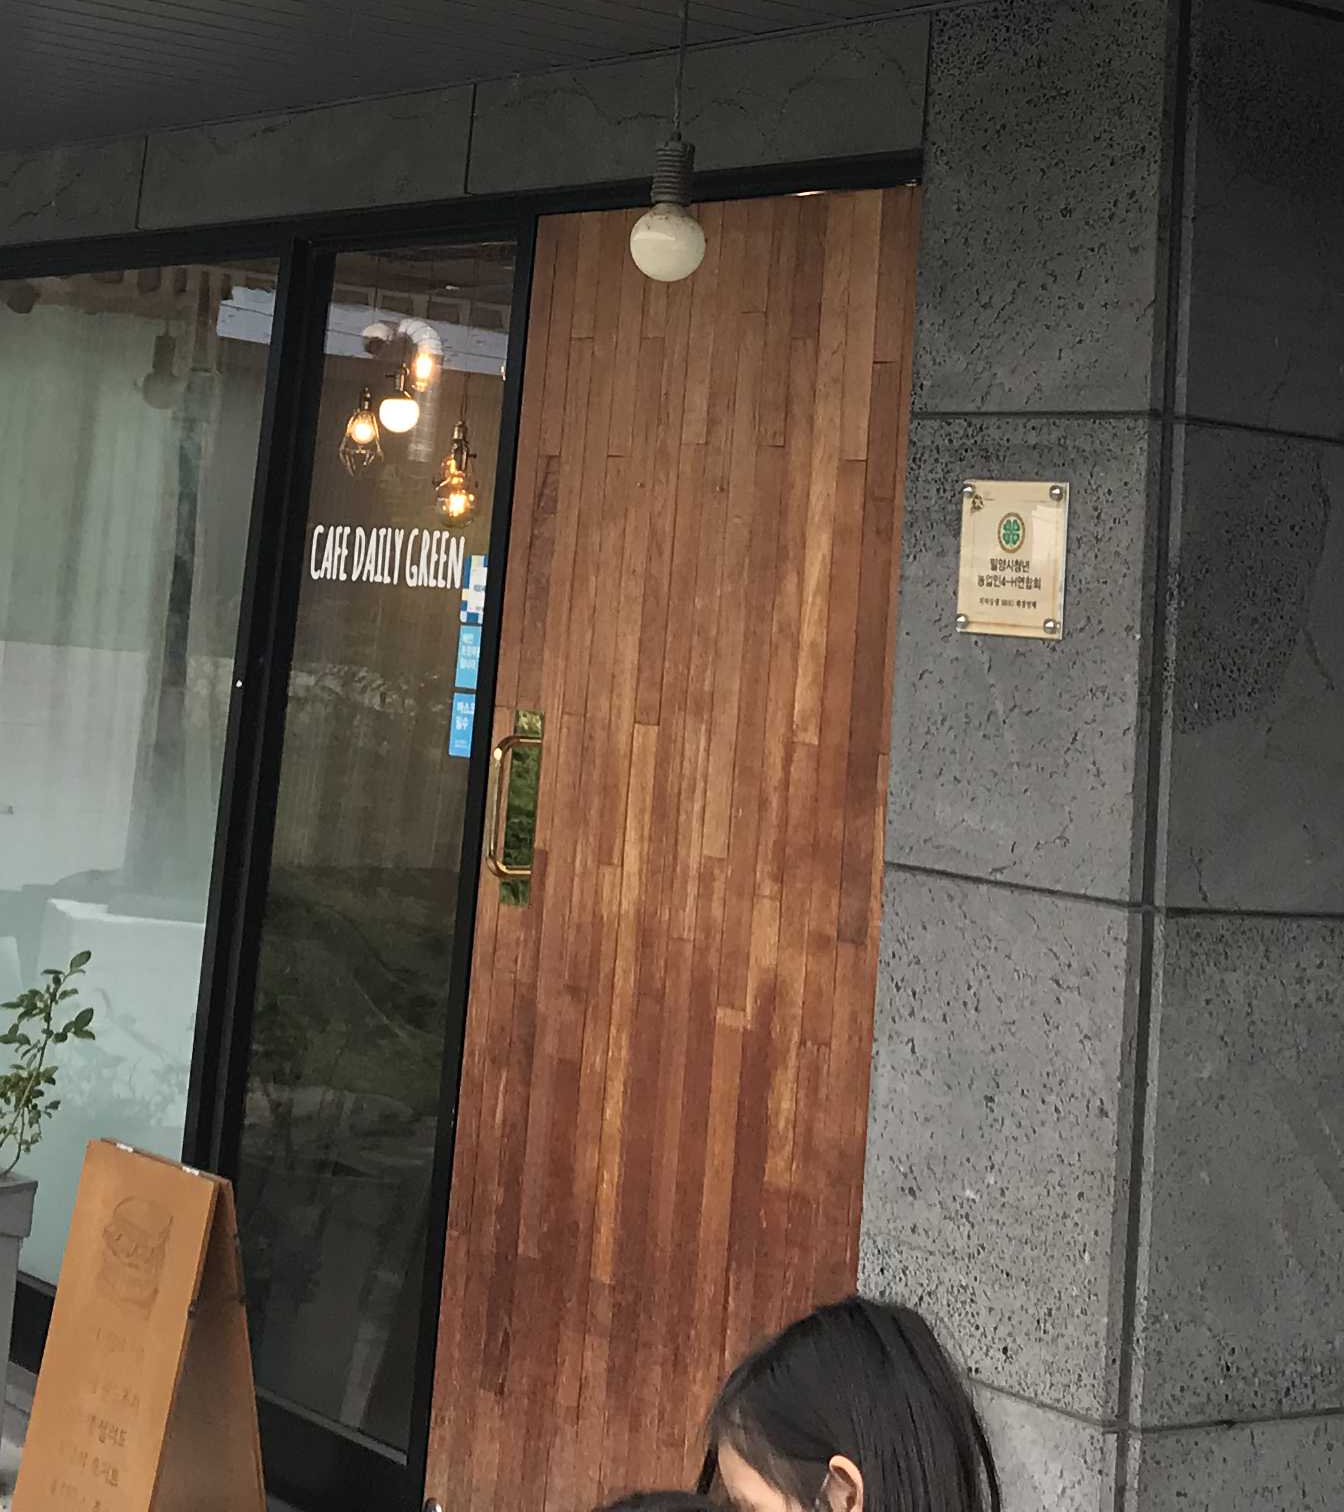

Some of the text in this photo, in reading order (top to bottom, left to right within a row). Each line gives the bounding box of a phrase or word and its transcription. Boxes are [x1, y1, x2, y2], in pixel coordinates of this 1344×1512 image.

[310, 525, 465, 589] CAFE DAILY GREEN
